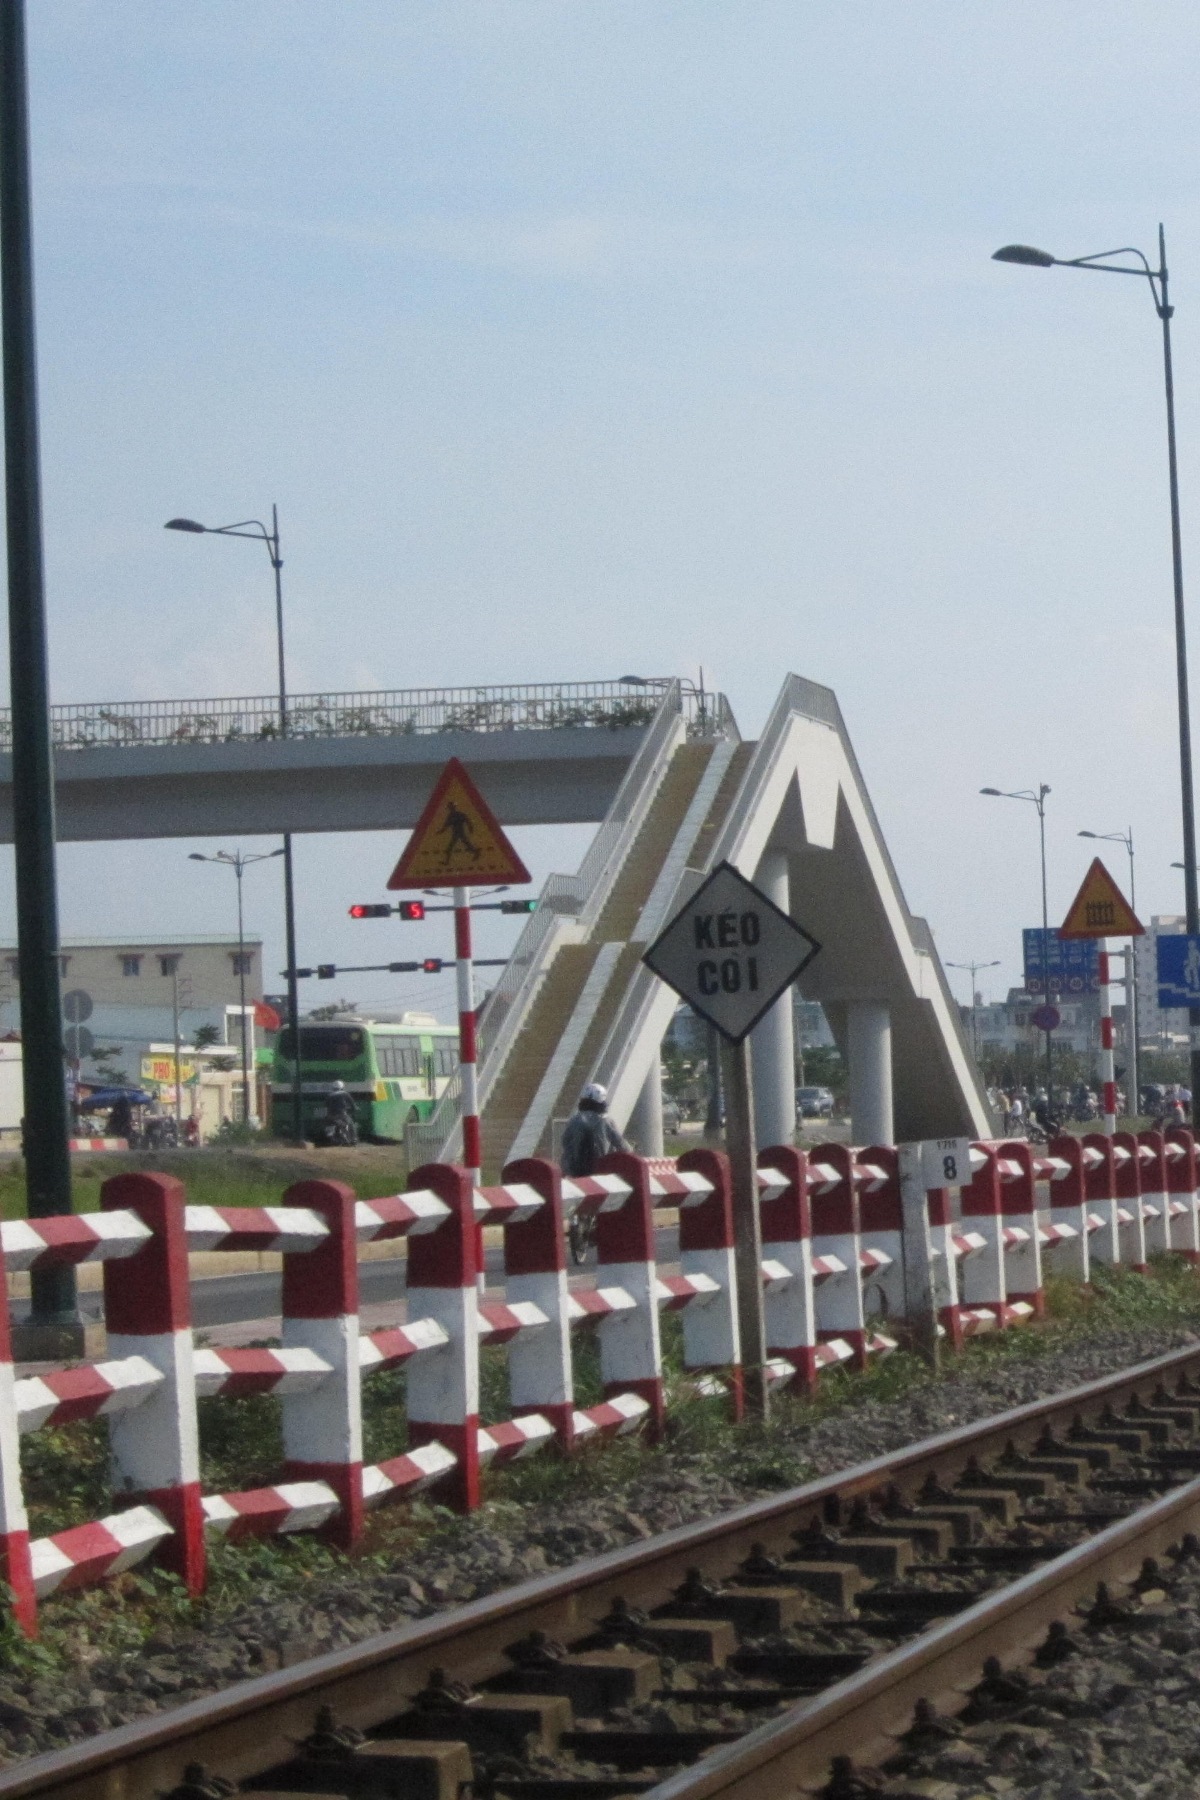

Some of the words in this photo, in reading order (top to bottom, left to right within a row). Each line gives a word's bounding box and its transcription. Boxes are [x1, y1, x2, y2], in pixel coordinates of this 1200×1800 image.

[411, 904, 421, 918] 5
[694, 906, 760, 949] KÉO
[942, 1155, 957, 1180] 8
